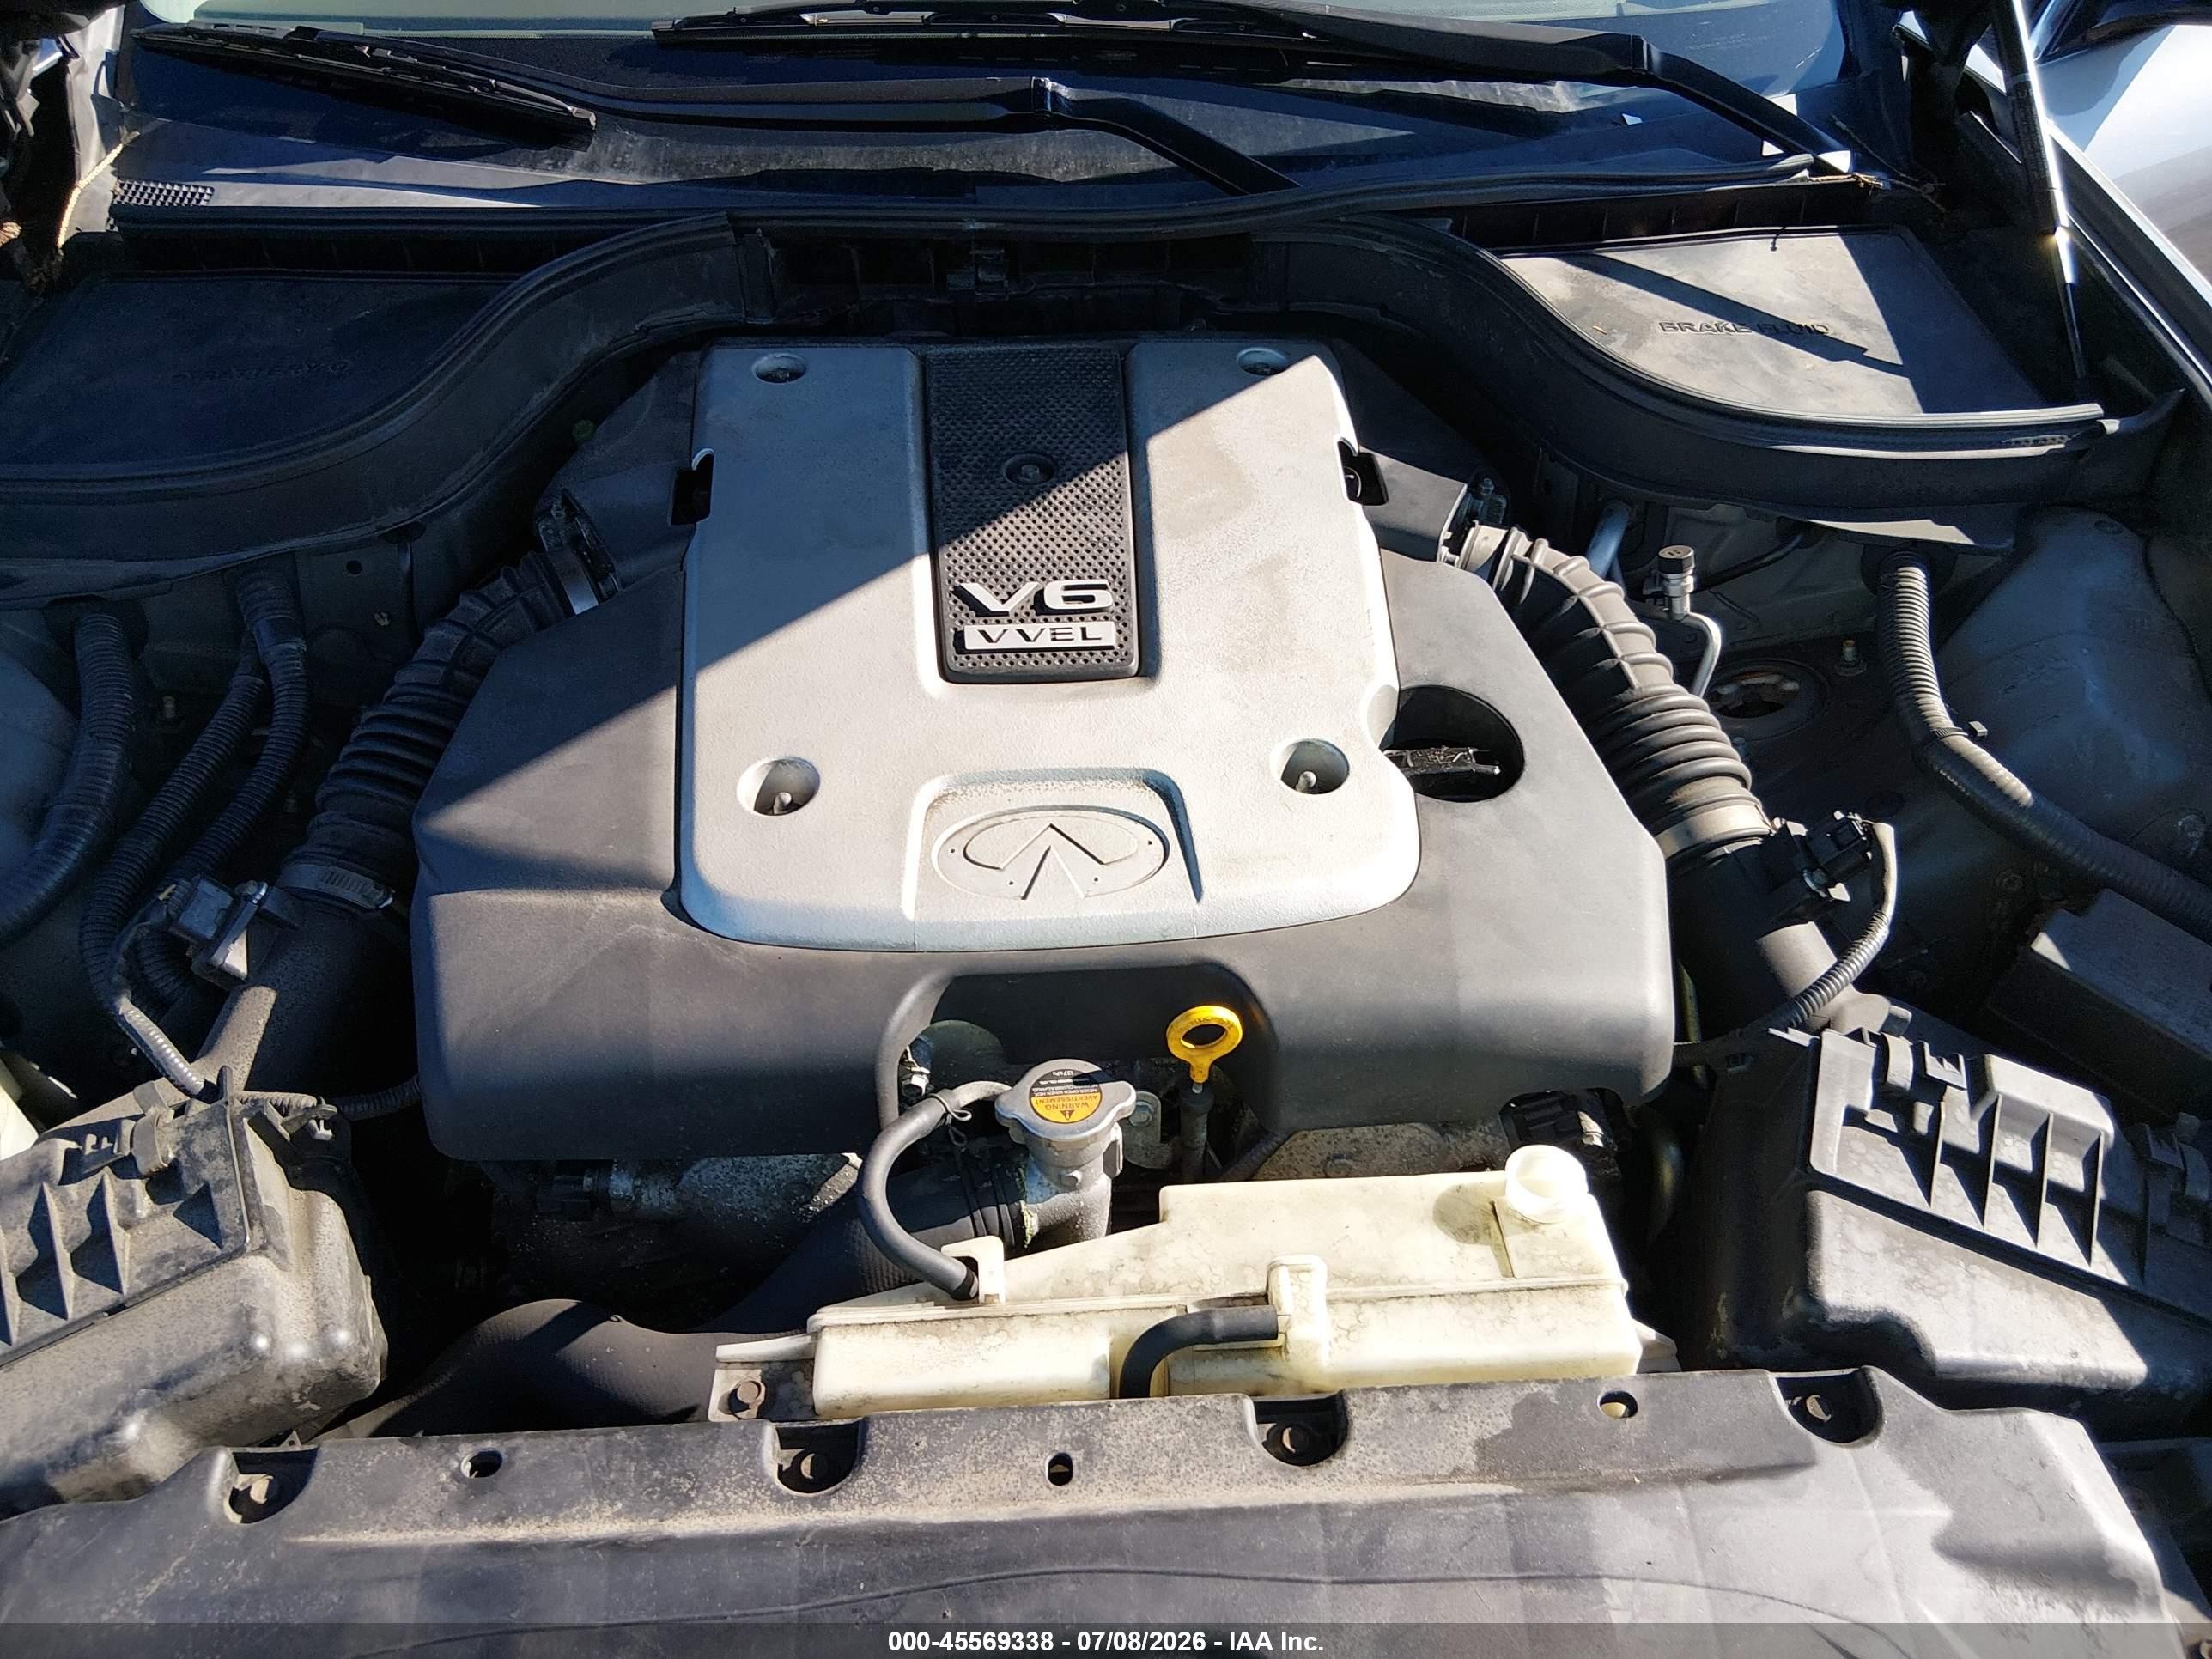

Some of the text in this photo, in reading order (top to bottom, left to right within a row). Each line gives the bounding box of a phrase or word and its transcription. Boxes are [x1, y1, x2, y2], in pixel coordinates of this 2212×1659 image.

[1658, 321, 1831, 335] BRAKE FLUID
[957, 579, 1114, 614] V6
[977, 626, 1103, 644] VVEL
[1035, 1095, 1098, 1105] AVERTISSEMENT
[1045, 1102, 1090, 1110] WARNING
